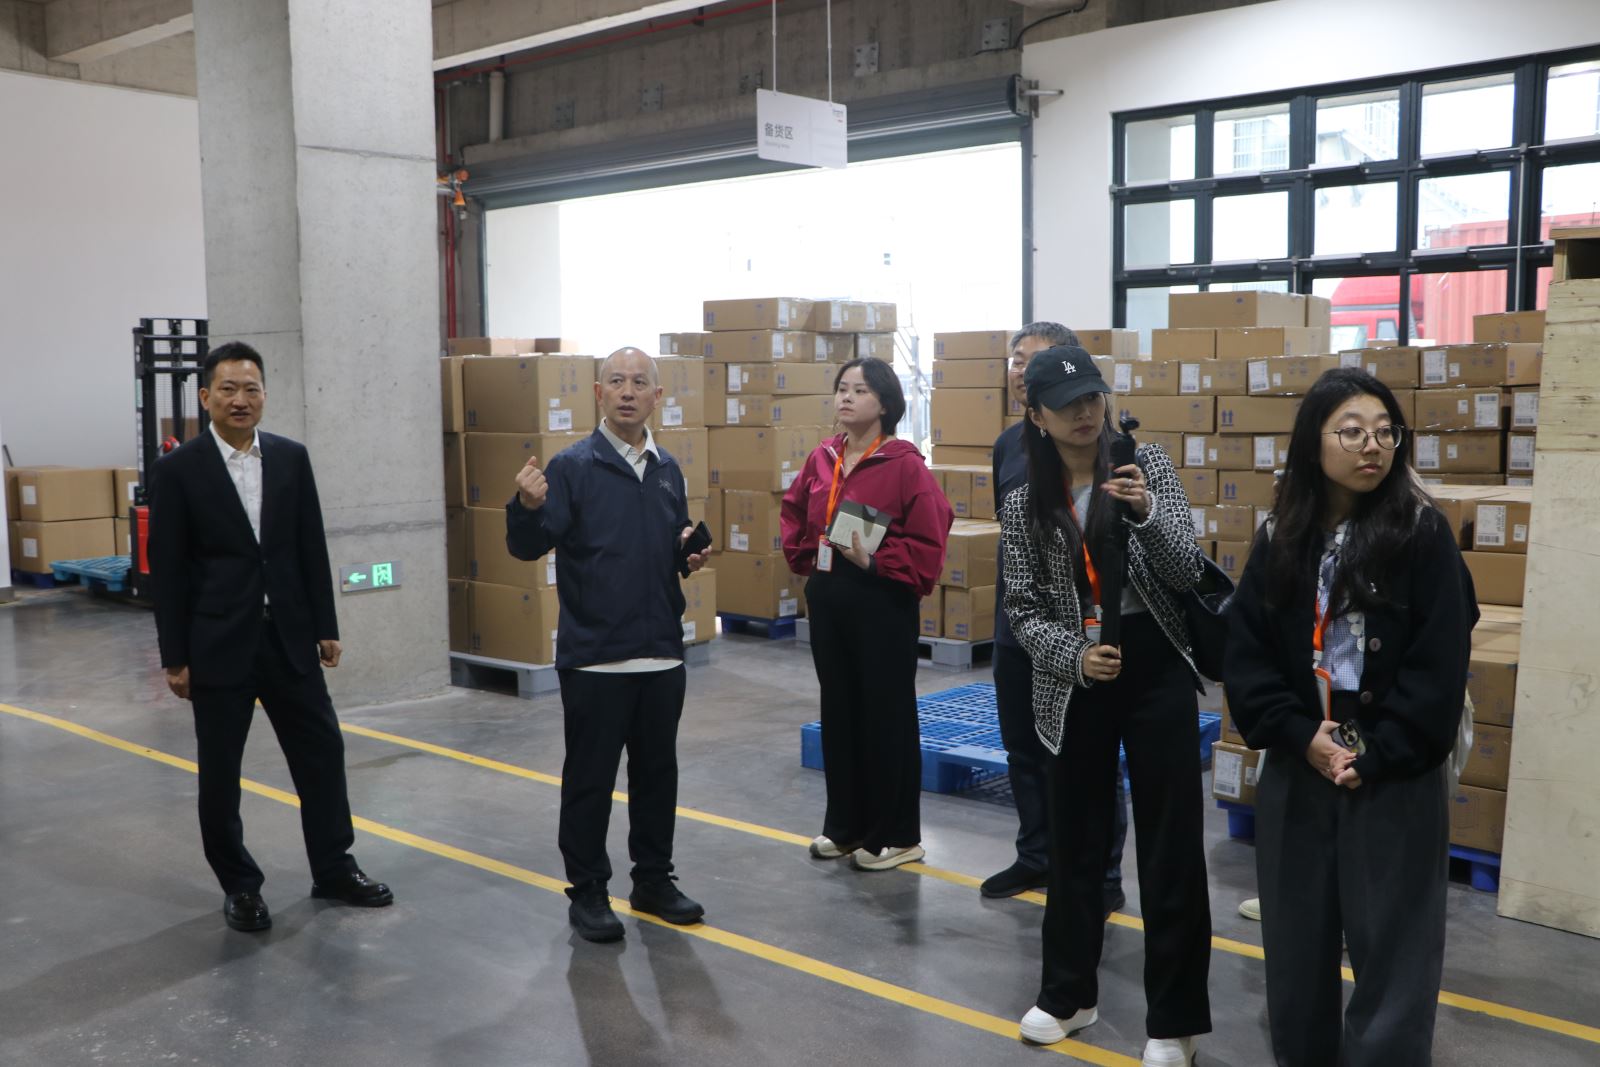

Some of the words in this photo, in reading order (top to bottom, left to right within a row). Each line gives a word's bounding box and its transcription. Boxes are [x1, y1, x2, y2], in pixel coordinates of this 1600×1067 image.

[764, 122, 794, 140] 备货区
[1062, 360, 1077, 374] LA
